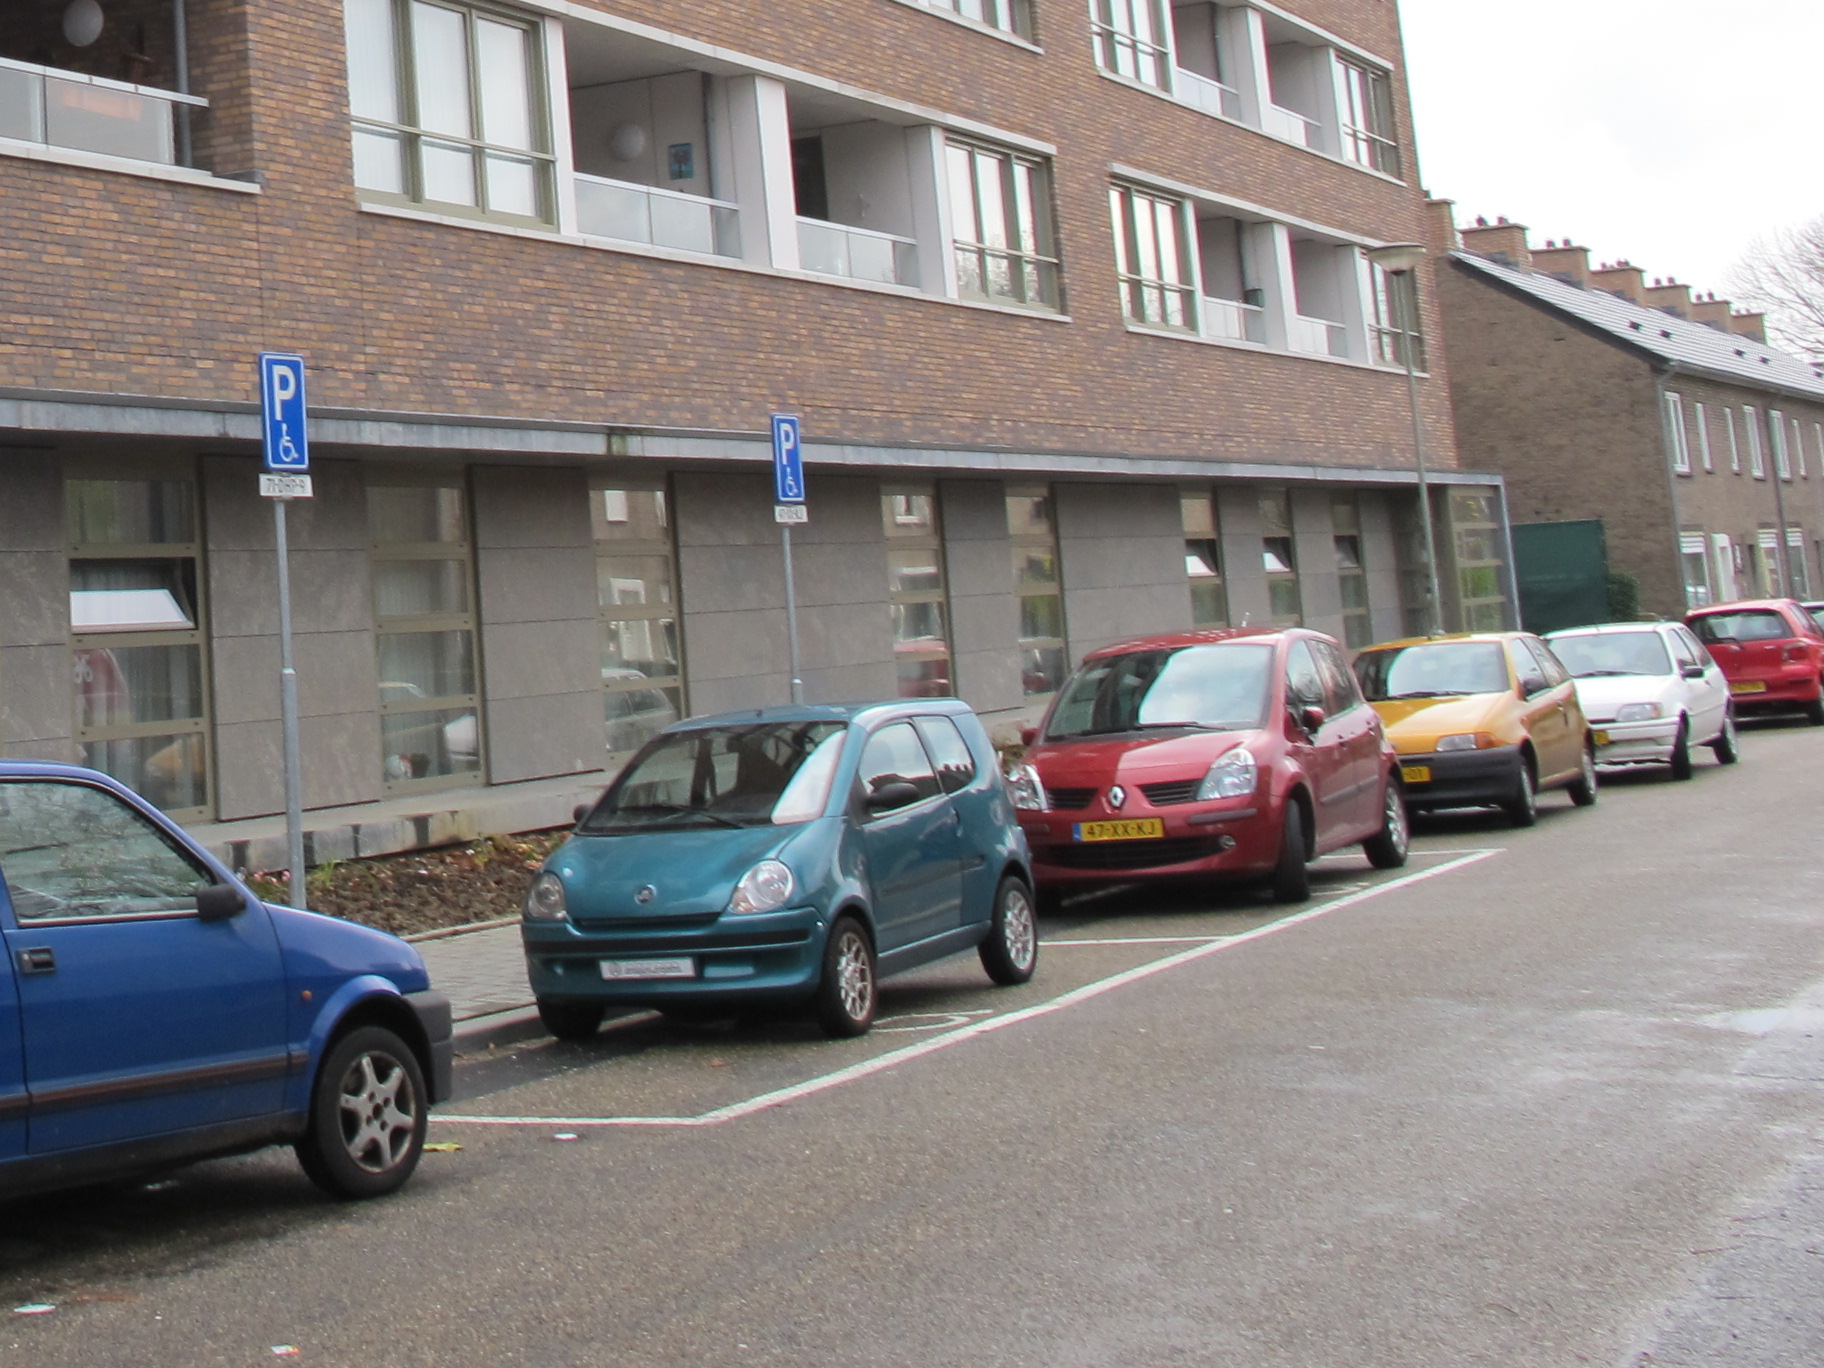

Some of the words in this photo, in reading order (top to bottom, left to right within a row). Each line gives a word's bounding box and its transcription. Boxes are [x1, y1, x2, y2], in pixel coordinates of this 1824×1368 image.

[272, 364, 296, 421] P
[779, 422, 795, 465] P
[1086, 819, 1156, 838] 47-XX-KJ
